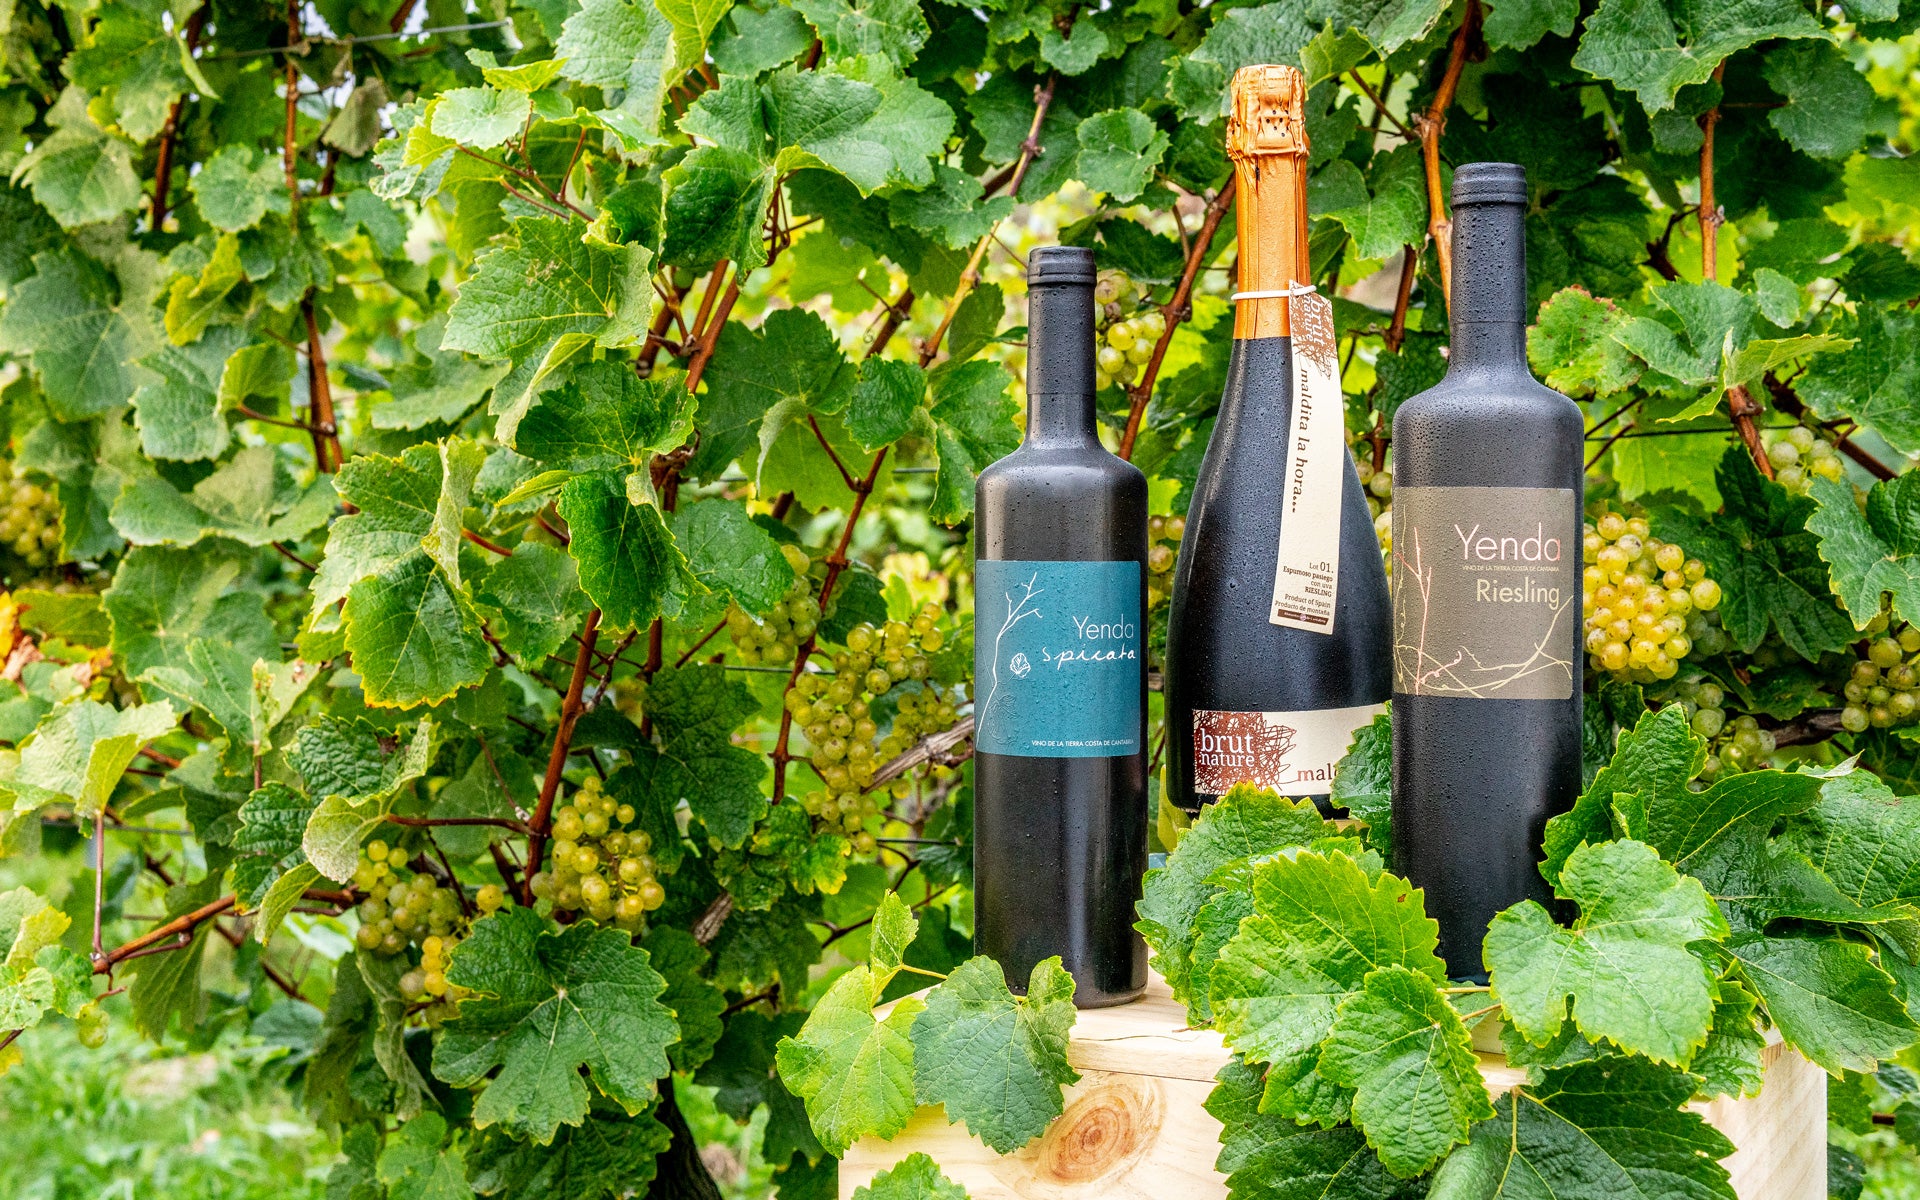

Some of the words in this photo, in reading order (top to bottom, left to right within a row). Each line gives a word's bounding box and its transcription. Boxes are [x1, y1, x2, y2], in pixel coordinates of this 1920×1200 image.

[1303, 293, 1313, 342] nature
[1311, 298, 1326, 347] brut
[1299, 369, 1313, 430] maldita
[1297, 436, 1310, 451] la
[1292, 457, 1308, 513] hora...
[1454, 521, 1561, 562] Yenda
[1283, 566, 1311, 577] Espumoso
[1312, 573, 1333, 582] pasiego
[1309, 562, 1319, 570] Lot
[1320, 561, 1334, 574] 01.
[1304, 586, 1332, 597] RIESLING
[1476, 576, 1560, 611] Riesling
[1275, 600, 1299, 610] Producto
[1285, 594, 1307, 603] Product
[1315, 600, 1331, 609] Spain
[1072, 613, 1135, 640] Yenda
[1111, 738, 1135, 746] CANTABRIA
[1200, 728, 1254, 754] brut
[1200, 751, 1255, 768] nature
[1297, 763, 1338, 781] mal
